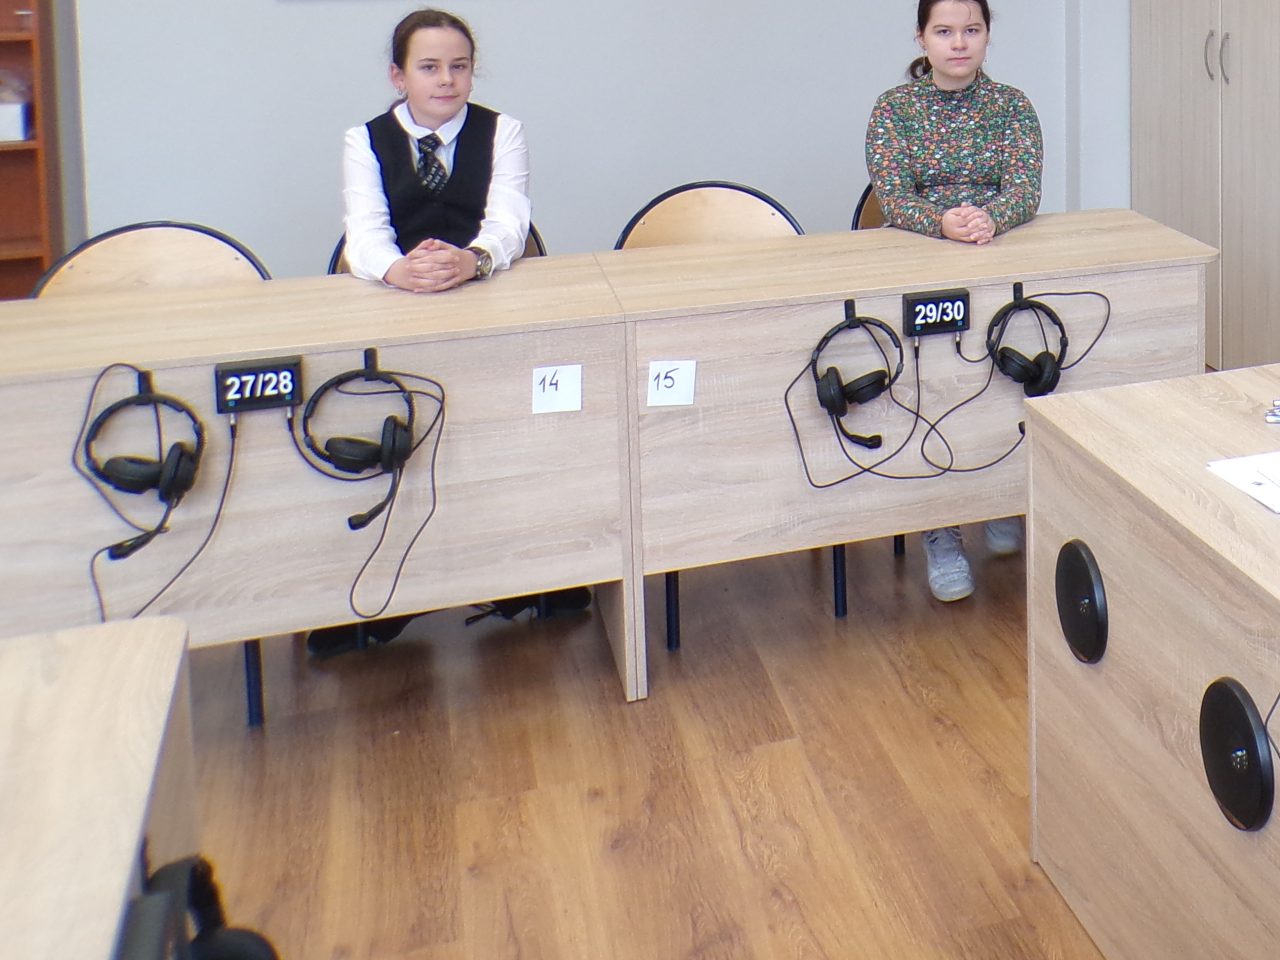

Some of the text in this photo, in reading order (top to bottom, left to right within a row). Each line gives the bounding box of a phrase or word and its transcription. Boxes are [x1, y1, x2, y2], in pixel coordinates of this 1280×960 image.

[915, 300, 964, 325] 29/30
[225, 370, 293, 400] 27/28
[538, 369, 559, 392] 14
[653, 367, 679, 390] 15
